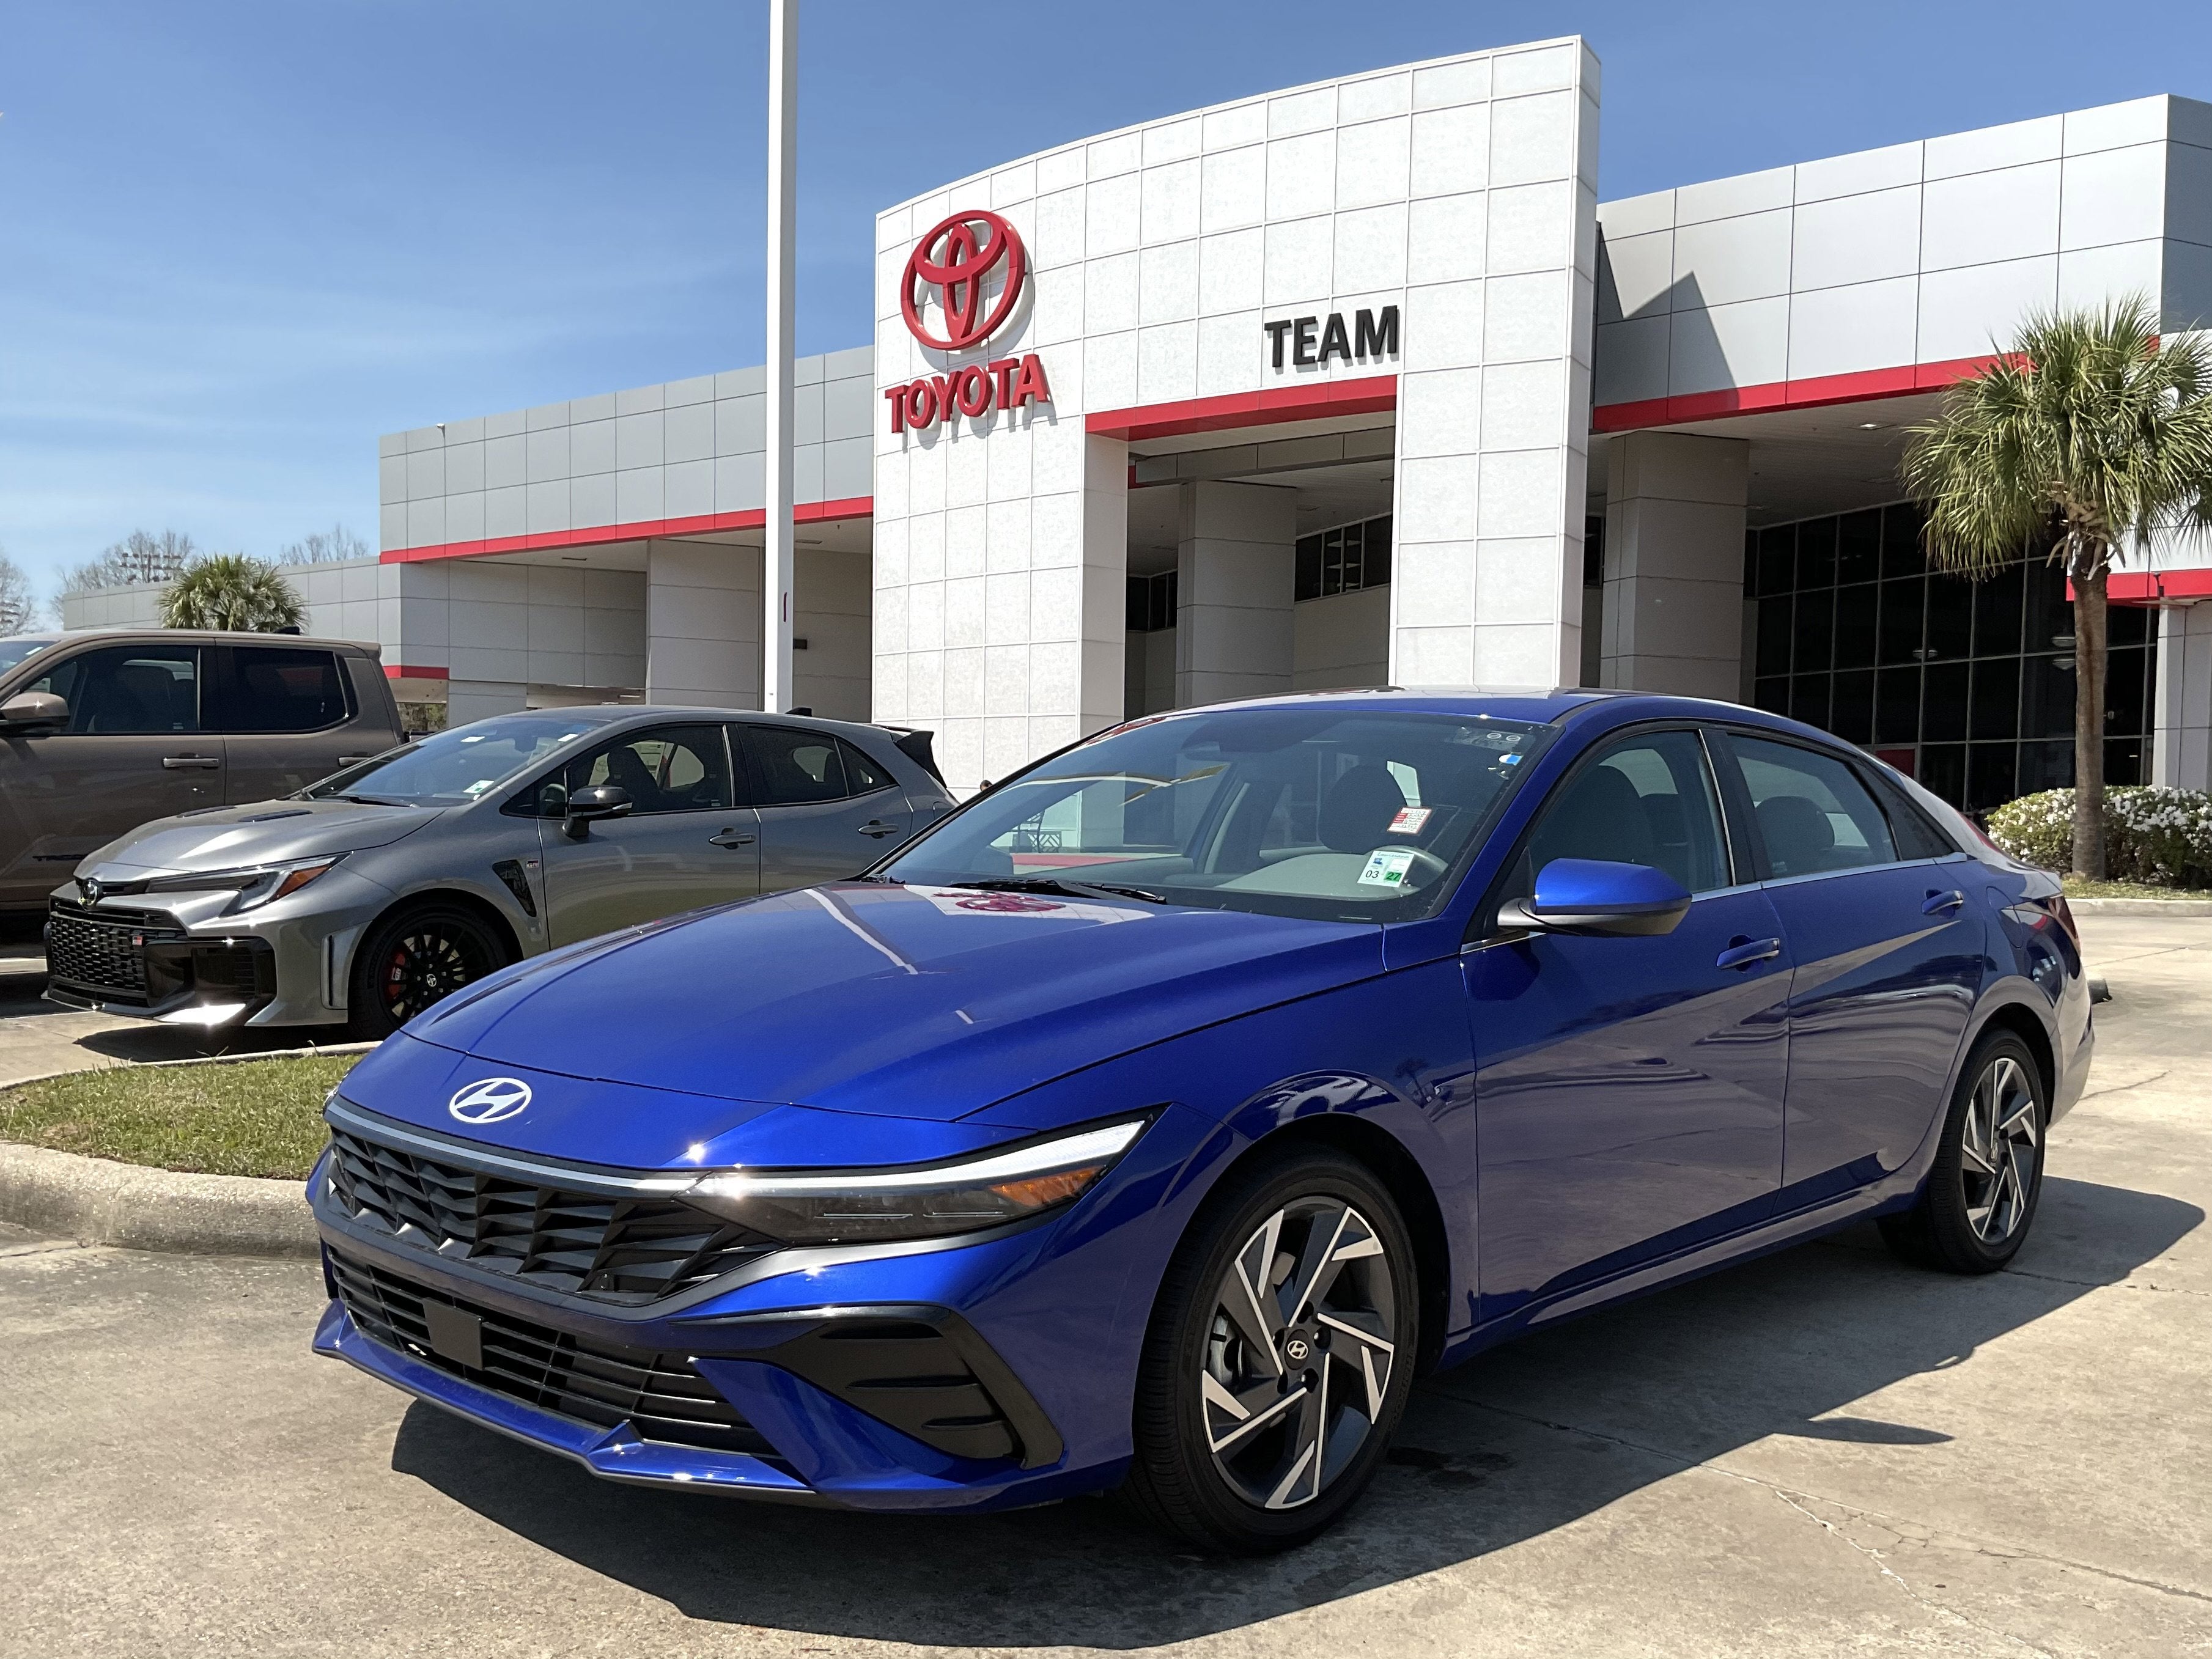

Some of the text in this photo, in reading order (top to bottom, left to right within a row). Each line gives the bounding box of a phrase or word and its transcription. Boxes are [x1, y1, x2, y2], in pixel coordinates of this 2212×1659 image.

[1265, 305, 1399, 367] TEAM
[885, 354, 1049, 433] TOYOTA
[1365, 870, 1379, 878] 03
[1386, 872, 1403, 880] 27
